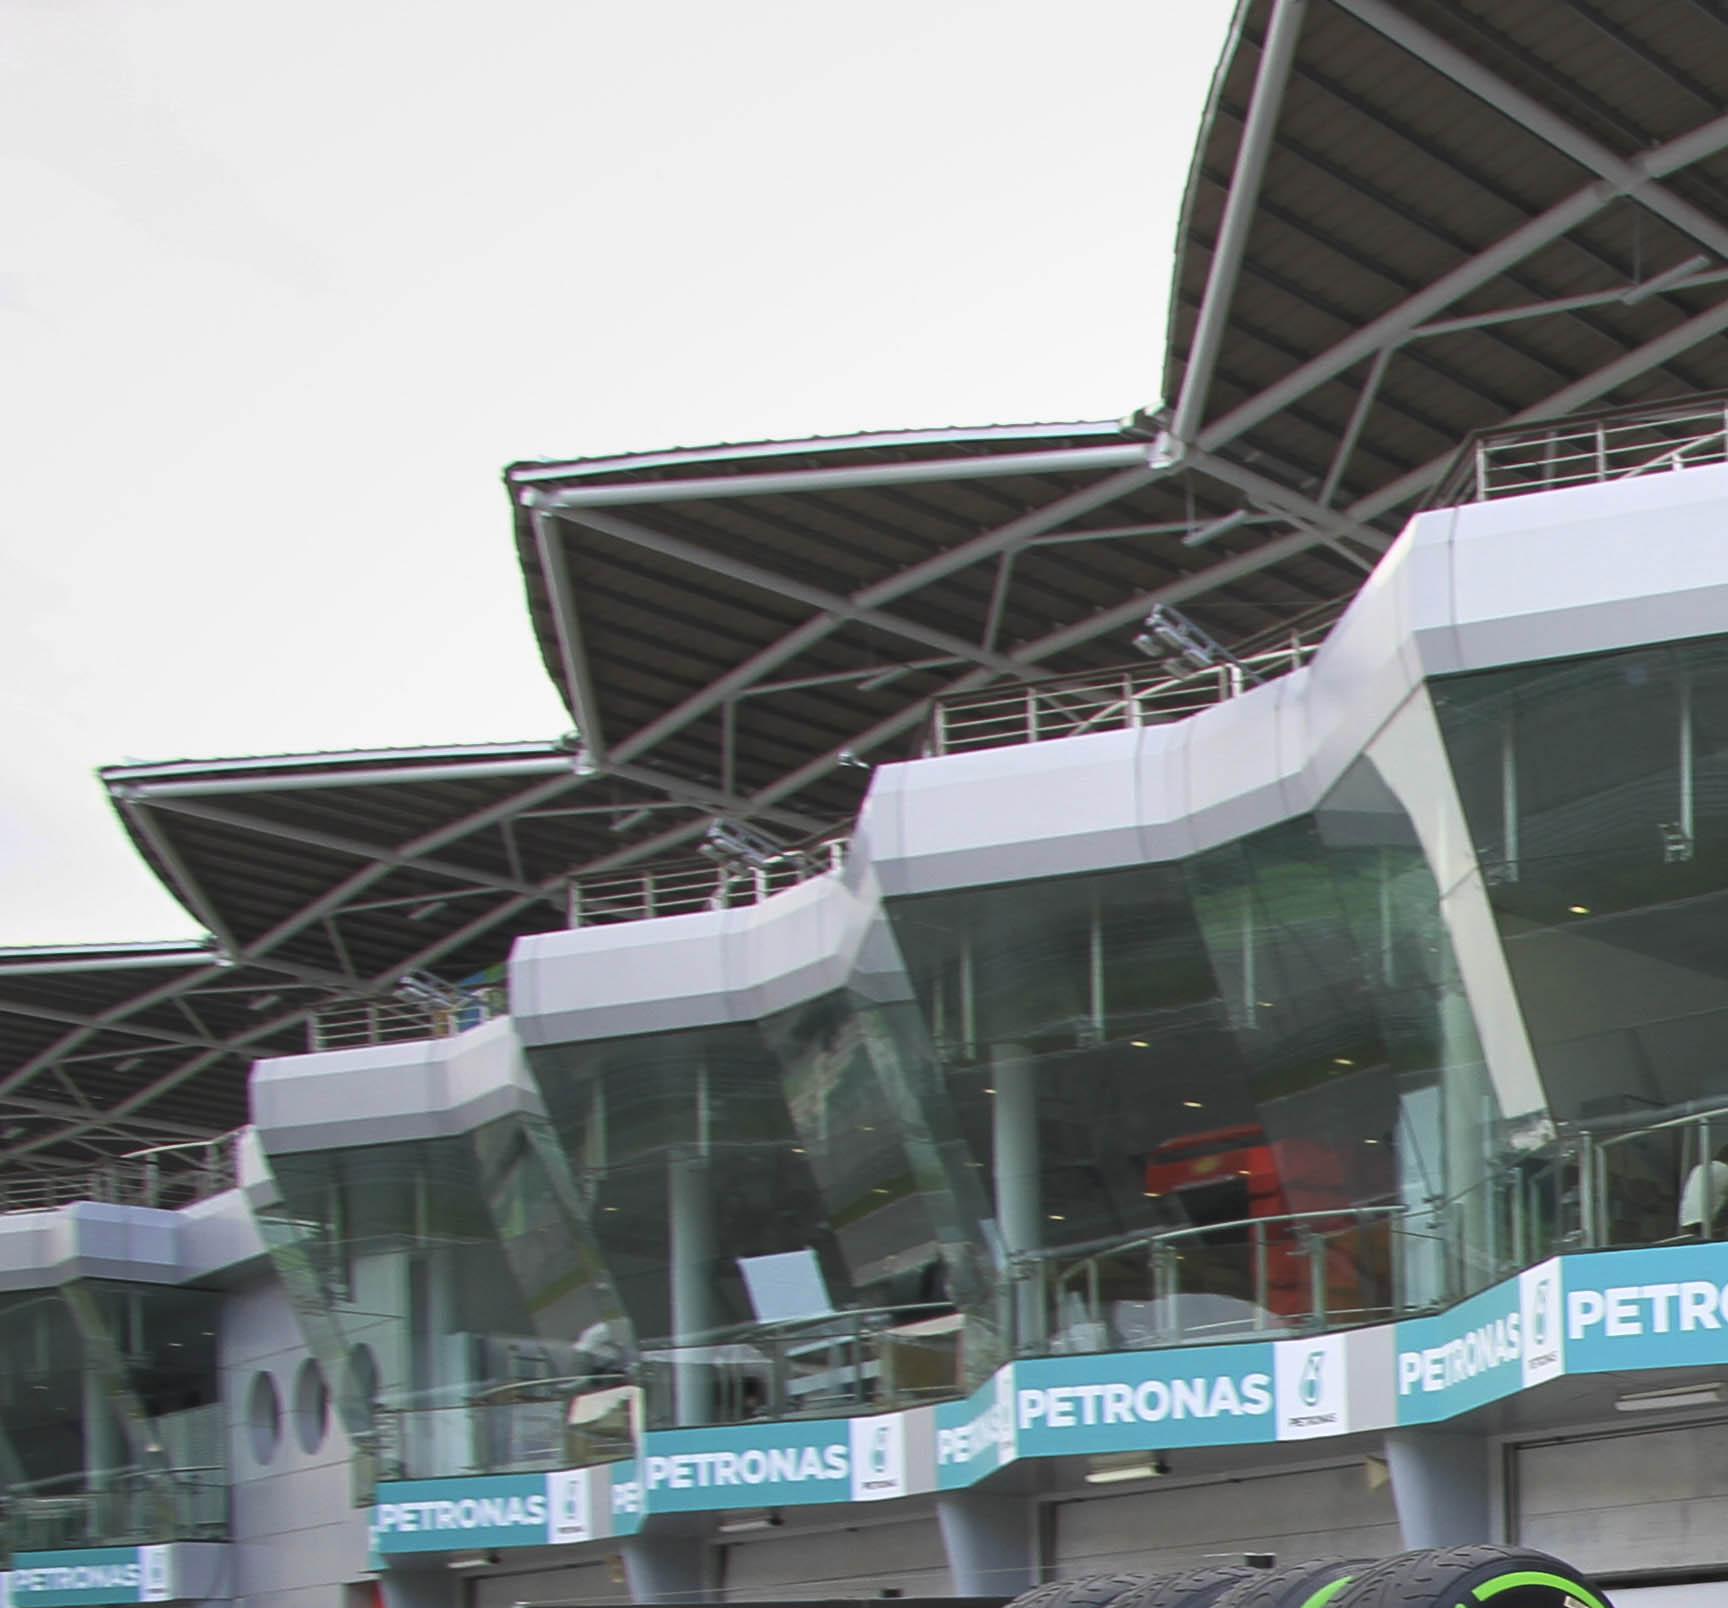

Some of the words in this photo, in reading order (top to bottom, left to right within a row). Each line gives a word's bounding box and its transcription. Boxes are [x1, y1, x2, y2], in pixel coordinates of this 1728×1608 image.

[1398, 1312, 1522, 1395] PETRONAS
[1018, 1373, 1273, 1430] PETRONAS
[646, 1444, 850, 1490] PETRONAS
[379, 1495, 547, 1532] PETRONAS
